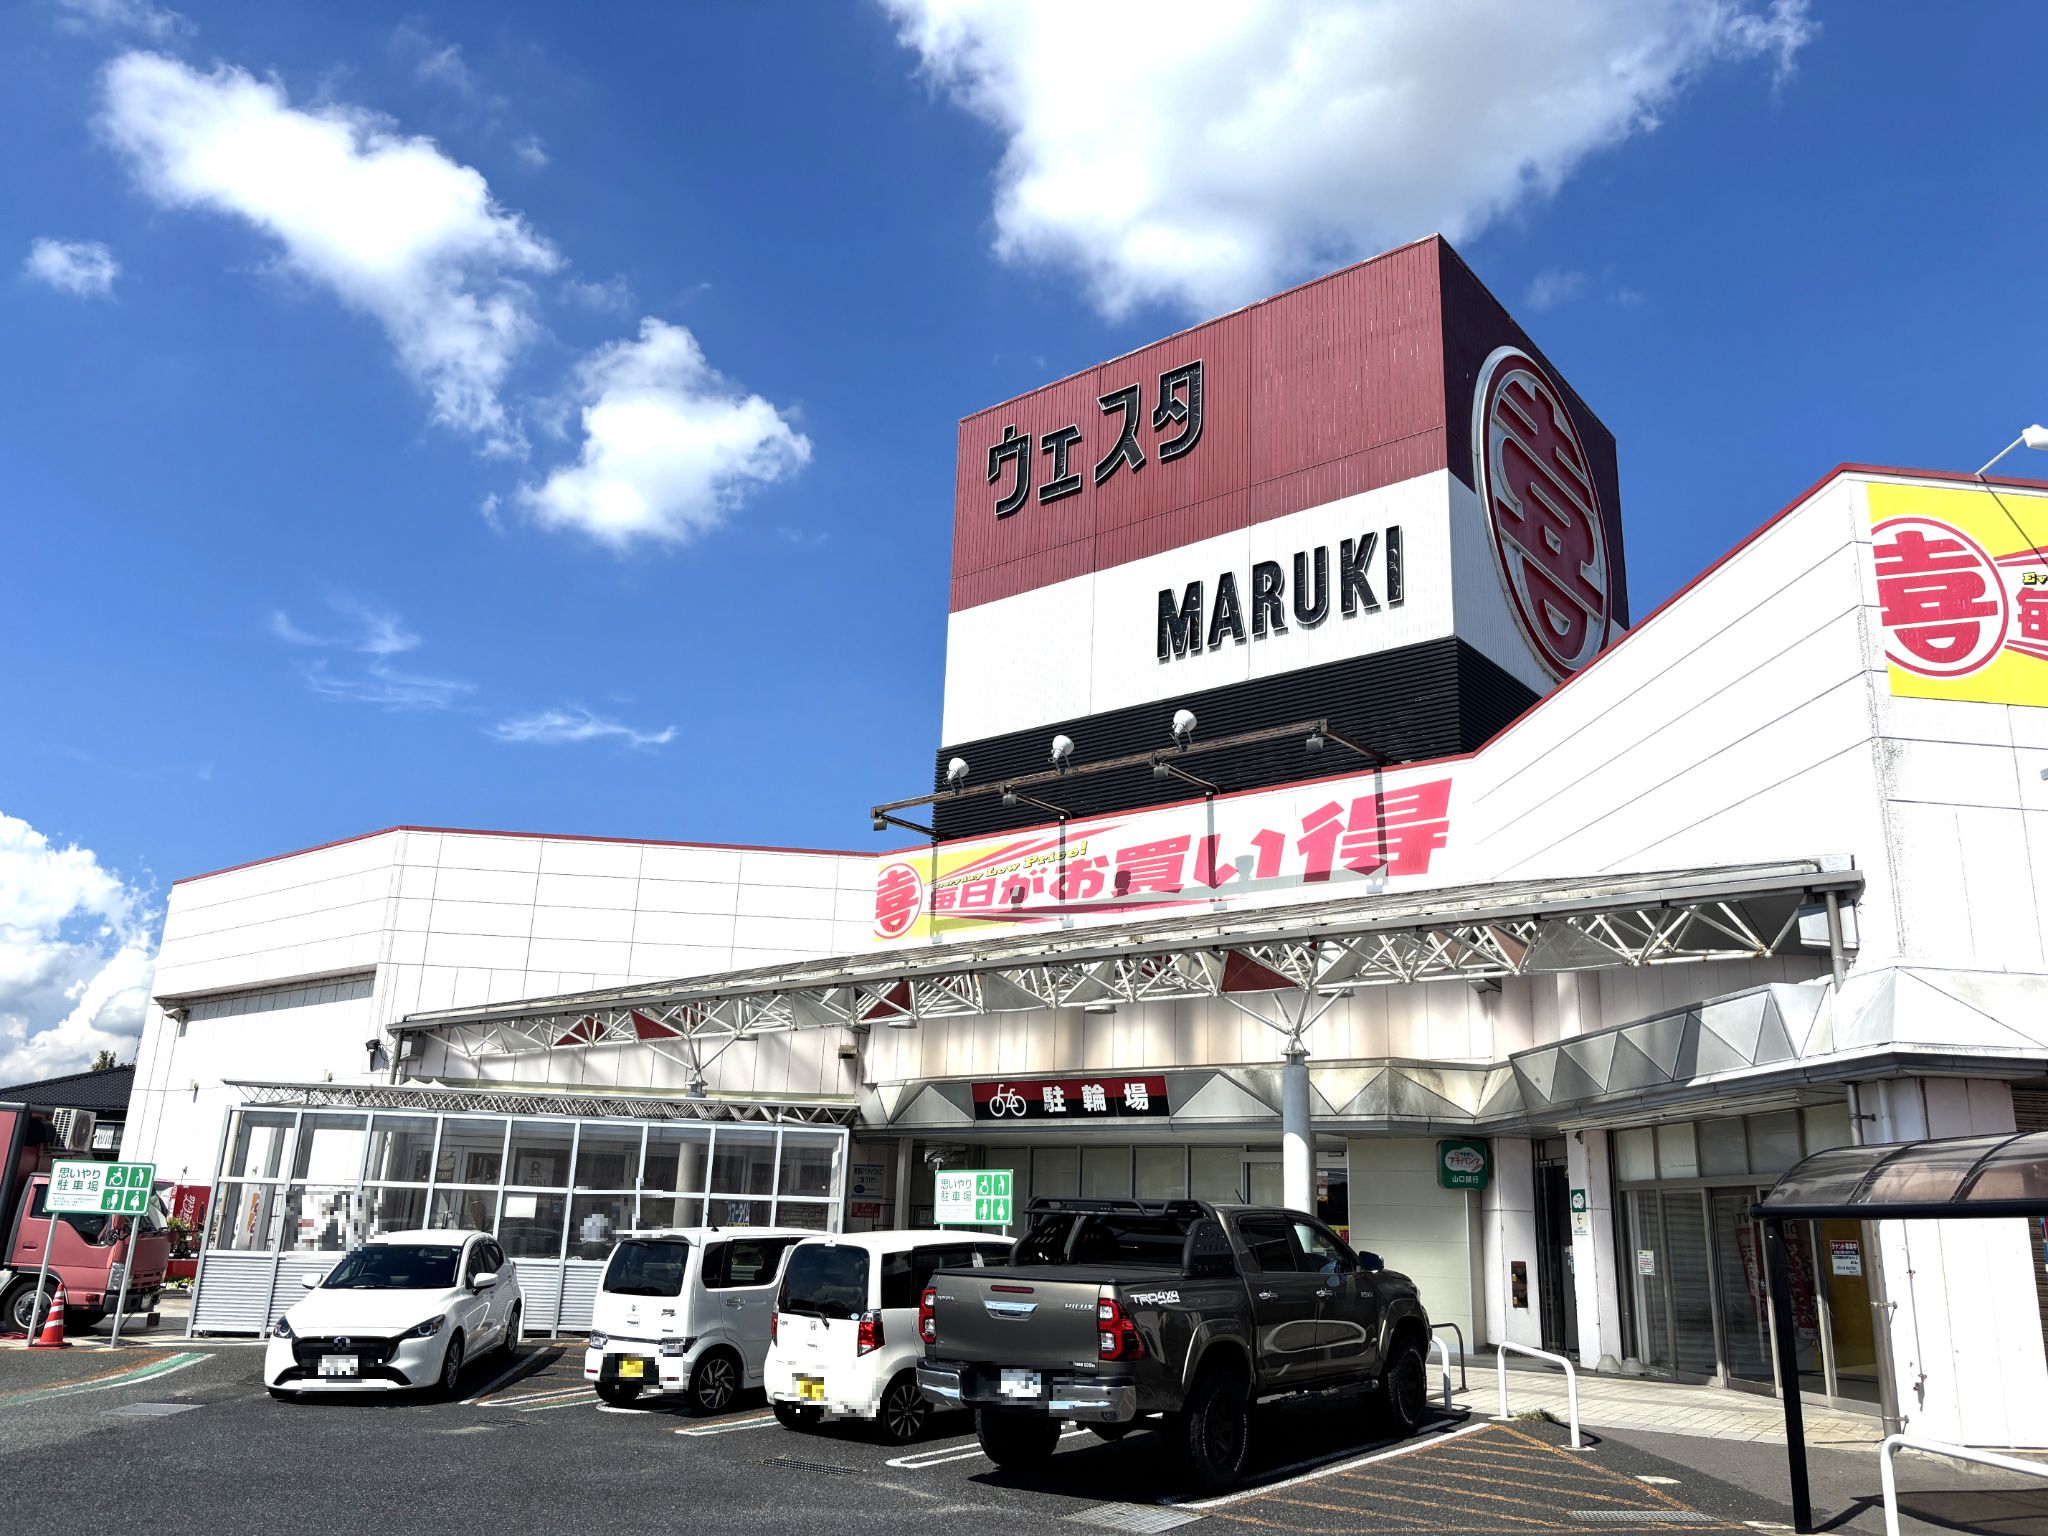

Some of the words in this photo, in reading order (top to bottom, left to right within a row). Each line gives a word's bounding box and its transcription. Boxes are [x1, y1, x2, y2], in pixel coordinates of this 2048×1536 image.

[986, 358, 1204, 517] ウェスタ
[1157, 524, 1404, 662] MARUKI
[929, 778, 1453, 911] 毎日がお買い得
[986, 863, 1021, 877] Low
[1023, 840, 1089, 869] Price!
[1042, 1083, 1149, 1113] 駐輪場
[56, 1179, 99, 1192] 駐車場
[58, 1167, 101, 1180] 思いやり
[941, 1178, 972, 1190] 思いやり
[941, 1190, 972, 1202] 駐車場
